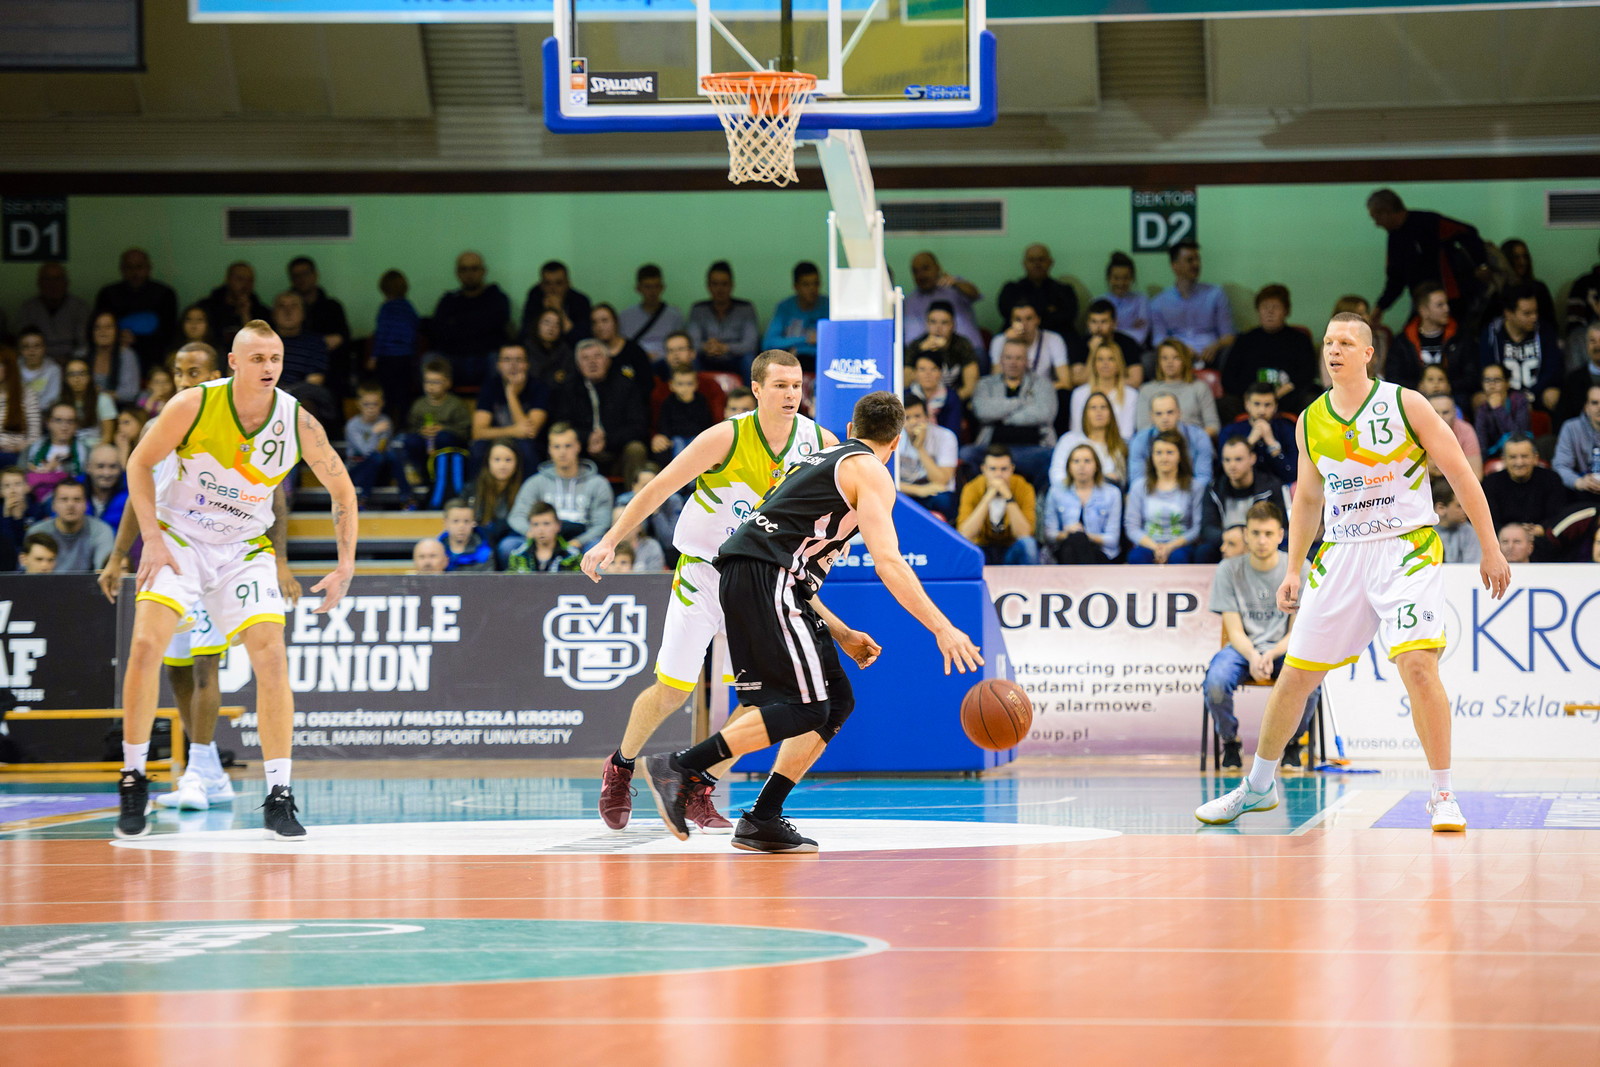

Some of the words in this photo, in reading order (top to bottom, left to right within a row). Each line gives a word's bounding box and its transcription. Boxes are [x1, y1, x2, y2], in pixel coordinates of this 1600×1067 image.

[590, 76, 653, 93] SPALDING
[1132, 190, 1195, 206] SEKTOR
[9, 221, 60, 255] D1
[1137, 211, 1192, 248] D2
[1368, 418, 1393, 445] 13
[262, 440, 285, 467] 91
[1341, 495, 1396, 512] TRANSITION
[1344, 517, 1403, 538] KROSNO
[236, 581, 259, 608] 91
[286, 596, 461, 643] EXTILE
[994, 592, 1198, 629] GROUP
[1397, 603, 1418, 630] 13
[287, 645, 433, 691] UNION
[1013, 663, 1115, 677] utsourcing
[1123, 665, 1206, 676] pracown
[402, 711, 464, 727] MIASTA
[516, 710, 584, 726] KROSNO
[332, 731, 382, 745] MARKI
[383, 730, 431, 745] MORO
[431, 729, 483, 745] SPORT
[483, 729, 573, 744] UNIVERSITY
